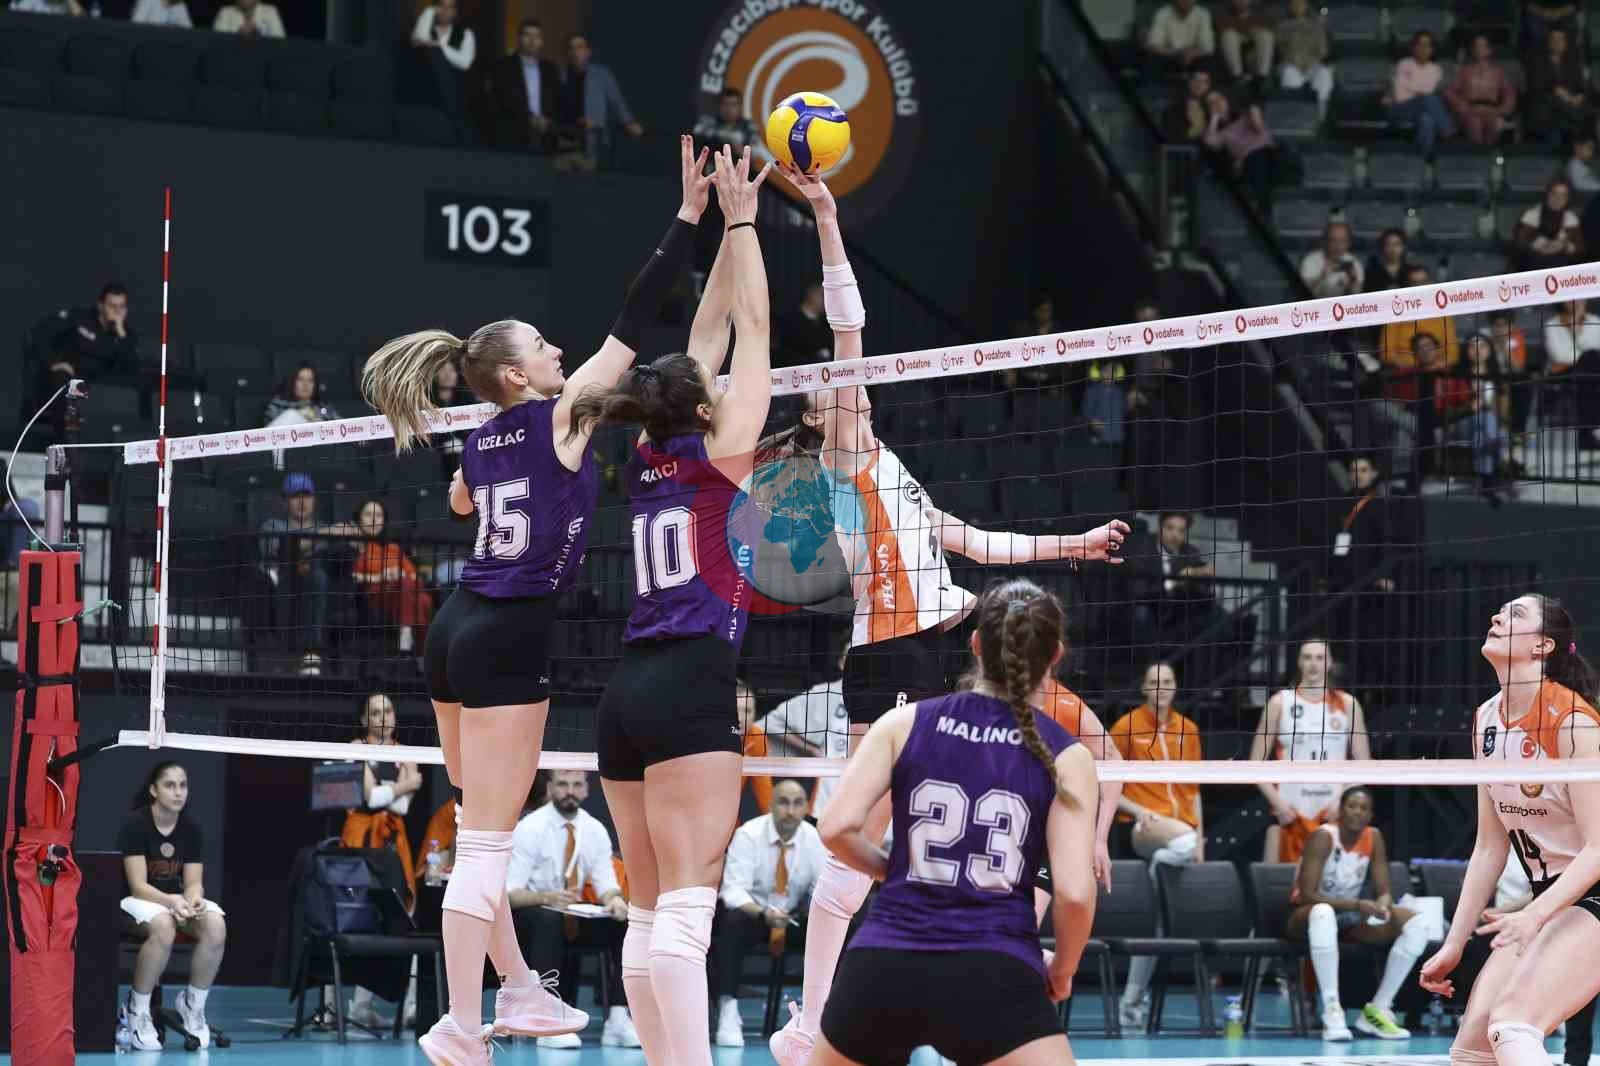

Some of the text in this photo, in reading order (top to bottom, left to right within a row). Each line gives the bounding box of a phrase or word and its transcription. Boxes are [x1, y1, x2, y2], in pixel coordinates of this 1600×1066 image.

[441, 204, 531, 255] 103
[830, 367, 855, 378] vodafone
[906, 359, 930, 369] vodafone
[951, 357, 964, 366] TVF
[984, 350, 1011, 360] vodafone
[1032, 346, 1045, 356] TVF
[1067, 339, 1095, 350] vodafone
[1117, 335, 1131, 345] TVF
[1155, 327, 1185, 338] vodafone
[1208, 324, 1223, 335] TVF
[1247, 316, 1279, 328] vodafone
[1304, 312, 1319, 321] TVF
[1345, 303, 1379, 315] vodafone
[1405, 299, 1422, 310] TVF
[1449, 290, 1484, 303] vodafone
[1512, 285, 1531, 297] TVF
[1559, 275, 1597, 287] vodafone
[477, 429, 526, 450] UZELAC
[473, 477, 530, 560] 15
[632, 506, 700, 598] 10
[906, 778, 1031, 894] 23
